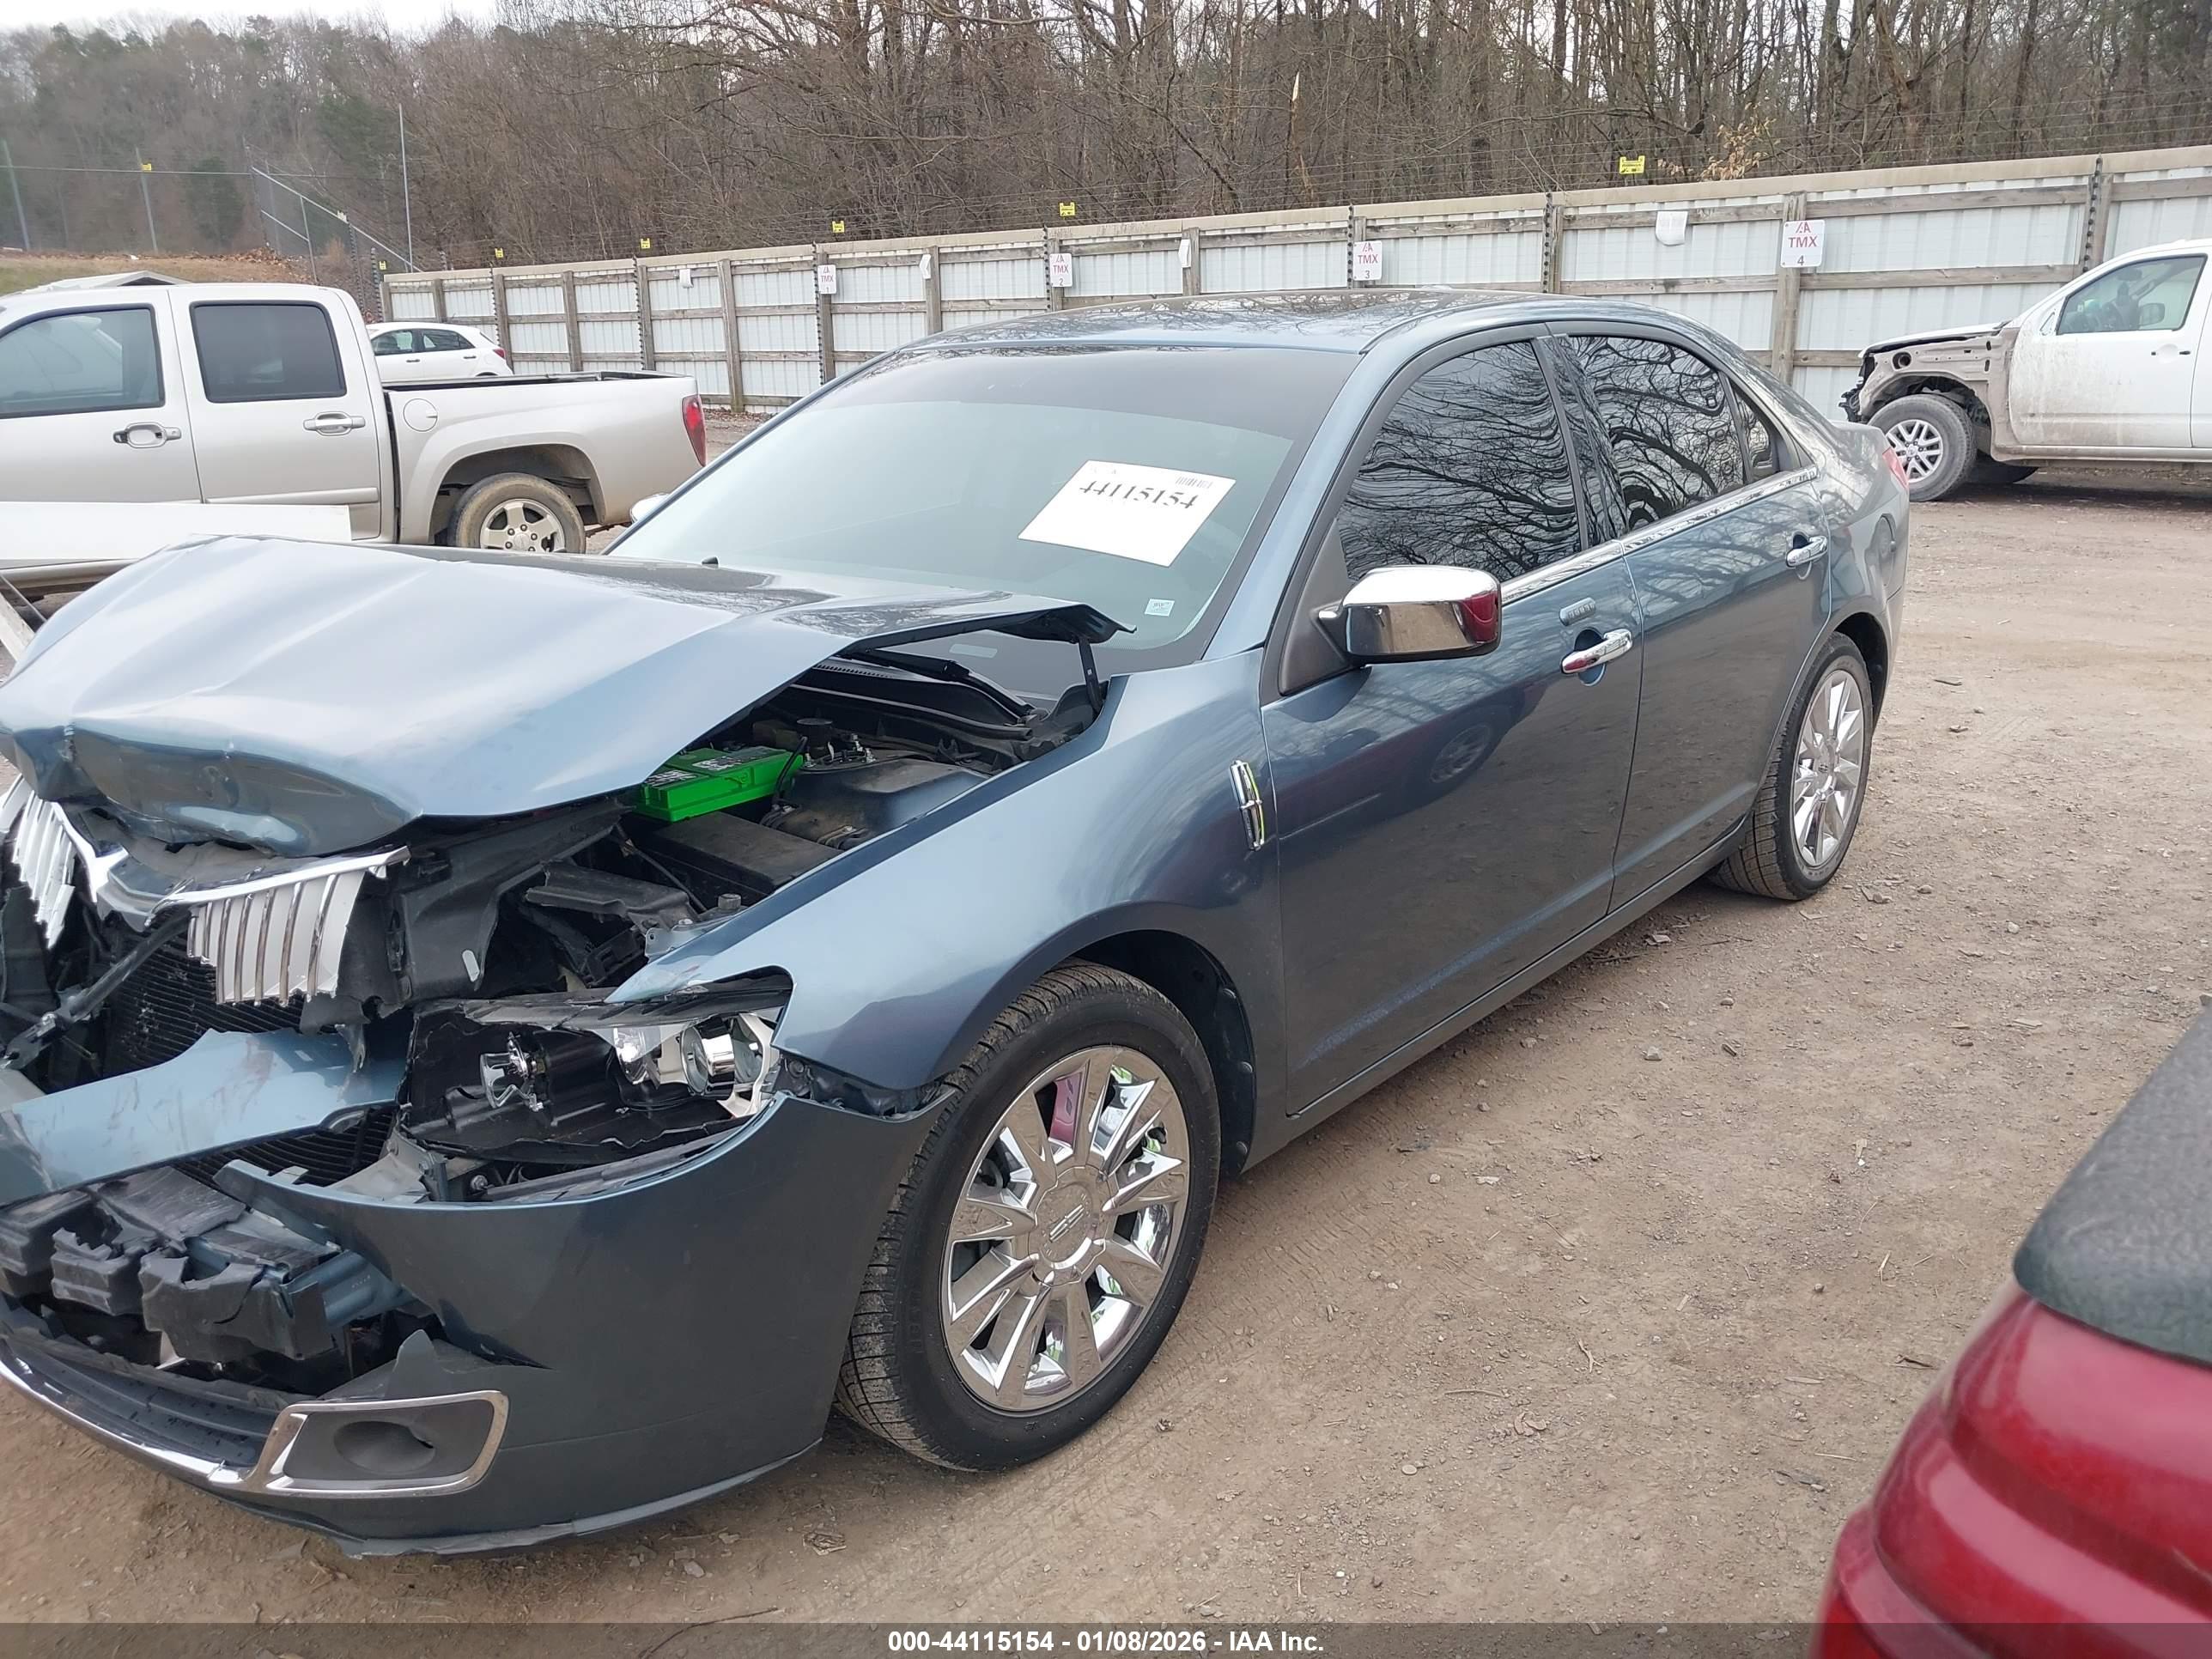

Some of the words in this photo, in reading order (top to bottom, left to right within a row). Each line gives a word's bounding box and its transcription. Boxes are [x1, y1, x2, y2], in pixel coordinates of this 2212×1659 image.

[1788, 235, 1818, 248] TMX
[1357, 253, 1379, 264] TMX
[1796, 254, 1805, 266] 4
[1053, 264, 1069, 275] TMX
[1364, 270, 1371, 279] 3
[1059, 277, 1065, 287] 2
[1079, 480, 1199, 509] 44115154
